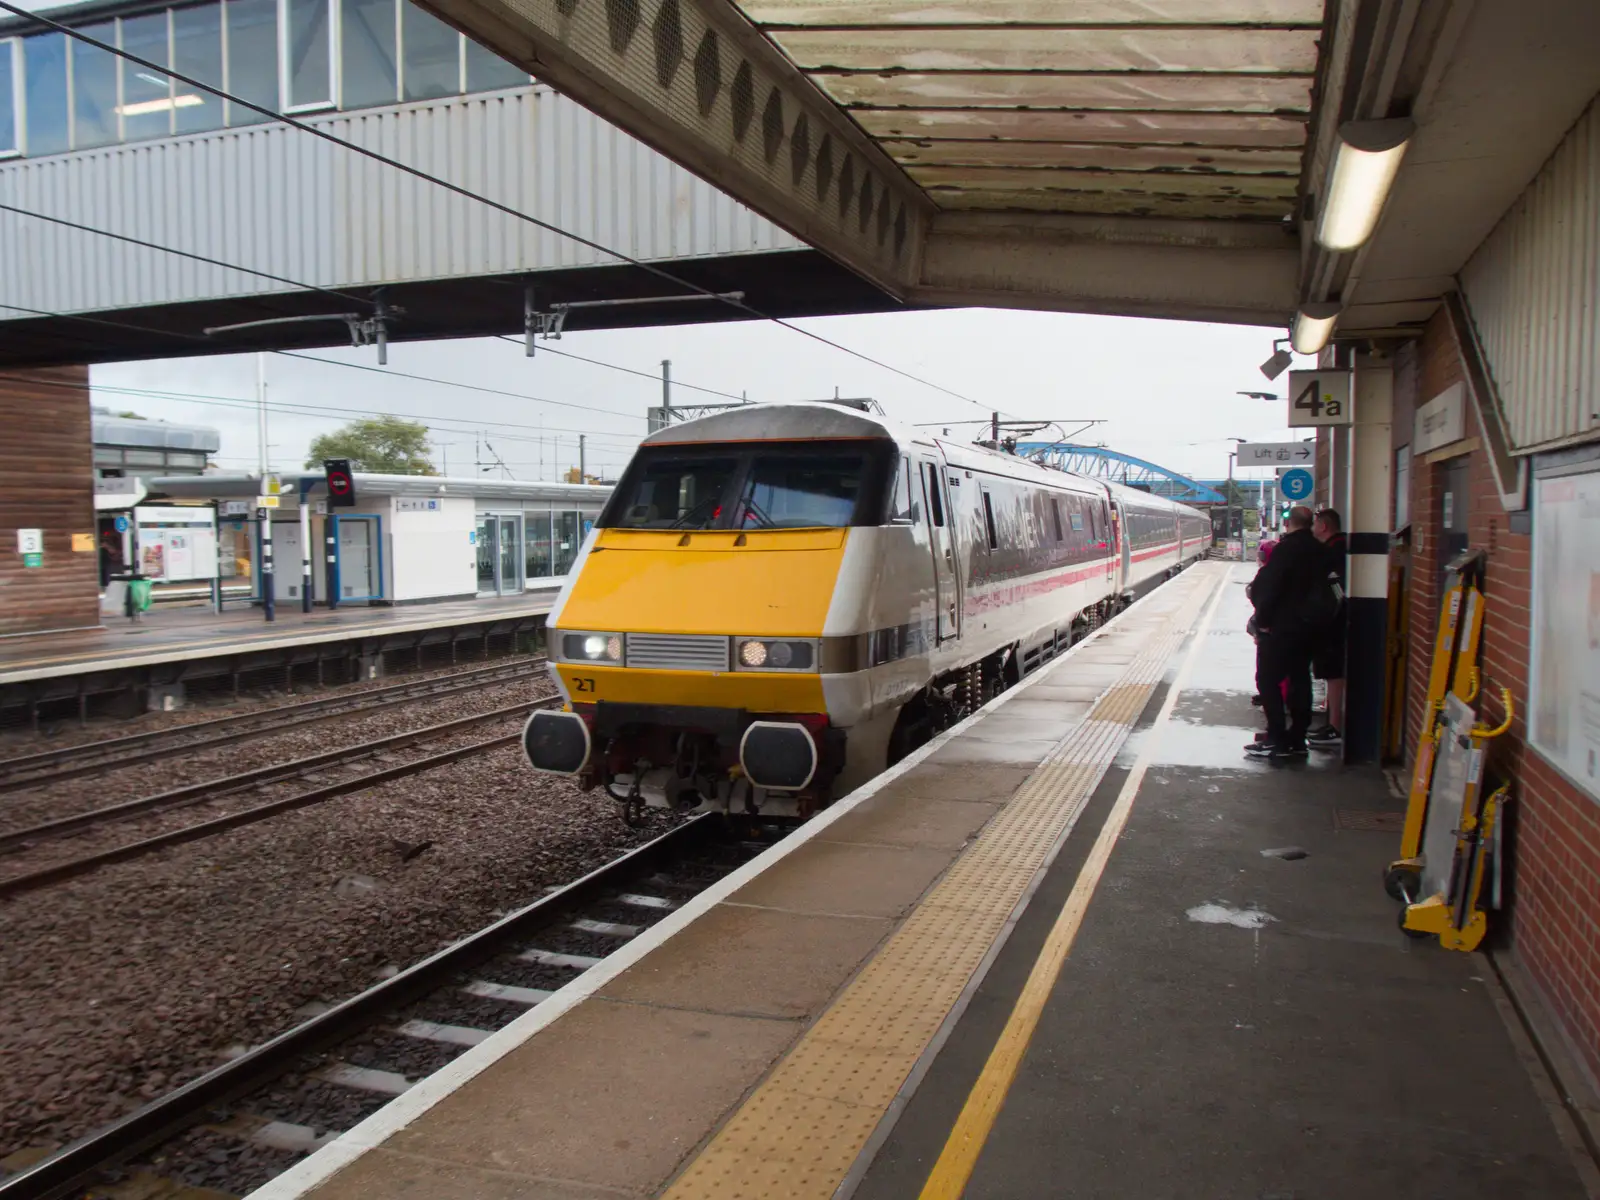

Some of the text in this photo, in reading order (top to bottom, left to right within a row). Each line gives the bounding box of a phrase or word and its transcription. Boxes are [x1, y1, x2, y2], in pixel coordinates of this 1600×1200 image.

[1254, 448, 1272, 459] Lift
[1291, 478, 1304, 493] 9
[571, 677, 596, 692] 27
